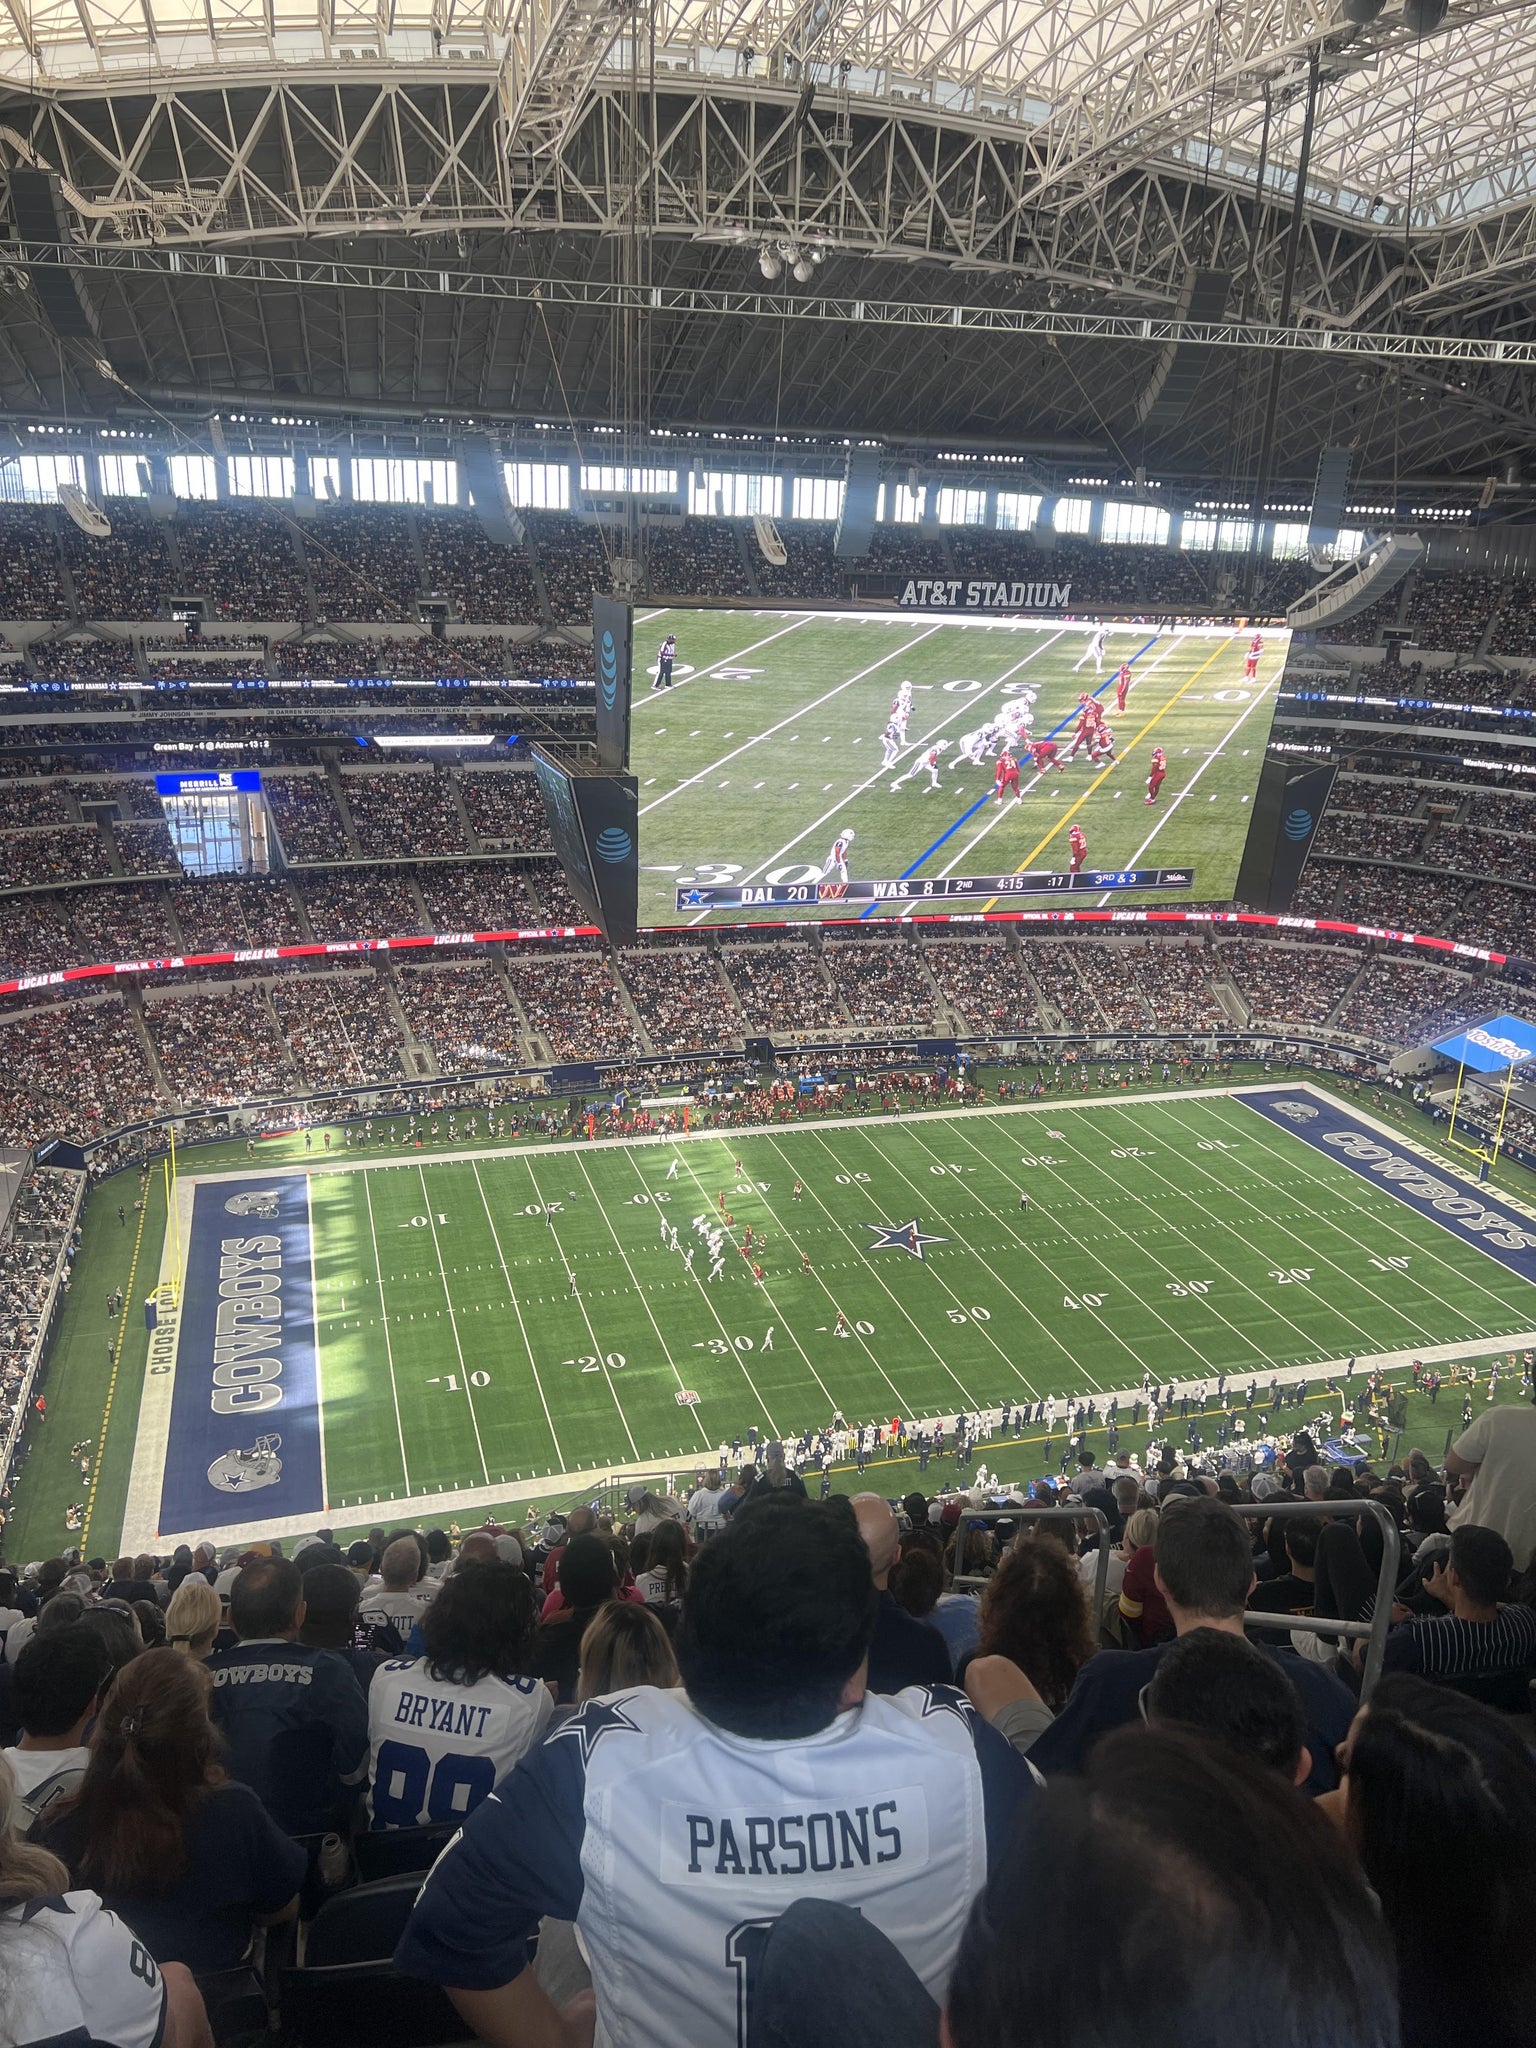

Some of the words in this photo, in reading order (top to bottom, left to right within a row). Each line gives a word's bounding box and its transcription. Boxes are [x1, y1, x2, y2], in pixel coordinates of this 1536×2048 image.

[900, 580, 962, 606] AT&T
[966, 581, 1072, 607] STADIUM
[153, 743, 177, 751] Green
[179, 742, 194, 752] Bay
[215, 741, 243, 750] Arizona
[1463, 758, 1503, 770] Washington
[180, 780, 219, 788] MERRILL
[741, 887, 776, 902] DAL
[787, 886, 808, 901] 20
[873, 882, 910, 897] WAS
[923, 881, 934, 895] 8
[955, 880, 973, 891] 2ND
[997, 877, 1024, 890] 4:15
[1047, 877, 1063, 887] :17
[1095, 874, 1115, 885] 3RD
[1117, 873, 1126, 883] &
[1129, 873, 1137, 883] 3
[1112, 912, 1135, 921] LUCAS
[1136, 912, 1148, 920] OIL
[1277, 917, 1302, 927] LUCAS
[1303, 919, 1317, 929] OIL
[433, 935, 460, 945] LUCAS
[461, 933, 475, 943] OIL
[234, 950, 263, 962] LUCAS
[264, 949, 279, 959] OIL
[1453, 943, 1478, 956] LUCAS
[1477, 949, 1491, 960] OIL
[18, 975, 48, 991] LUCAS
[49, 972, 65, 984] OIL
[1467, 1029, 1532, 1060] TOSTITOS
[1399, 1138, 1418, 1147] IT
[1420, 1149, 1470, 1177] TAKES
[1504, 1199, 1532, 1213] OF
[1322, 1131, 1536, 1250] COWBOYS
[1367, 1256, 1410, 1273] 10
[1268, 1267, 1312, 1284] 20
[1166, 1279, 1210, 1297] 30
[1063, 1292, 1105, 1311] 40
[946, 1306, 992, 1324] 50
[211, 1235, 283, 1415] COWBOYS
[150, 1318, 177, 1375] CHOOSE
[706, 1334, 755, 1356] 30
[575, 1352, 628, 1373] 20
[443, 1370, 491, 1393] 10
[210, 1663, 313, 1688] OWBOYS
[394, 1691, 492, 1738] BRYANT
[686, 1800, 902, 1875] PARSONS
